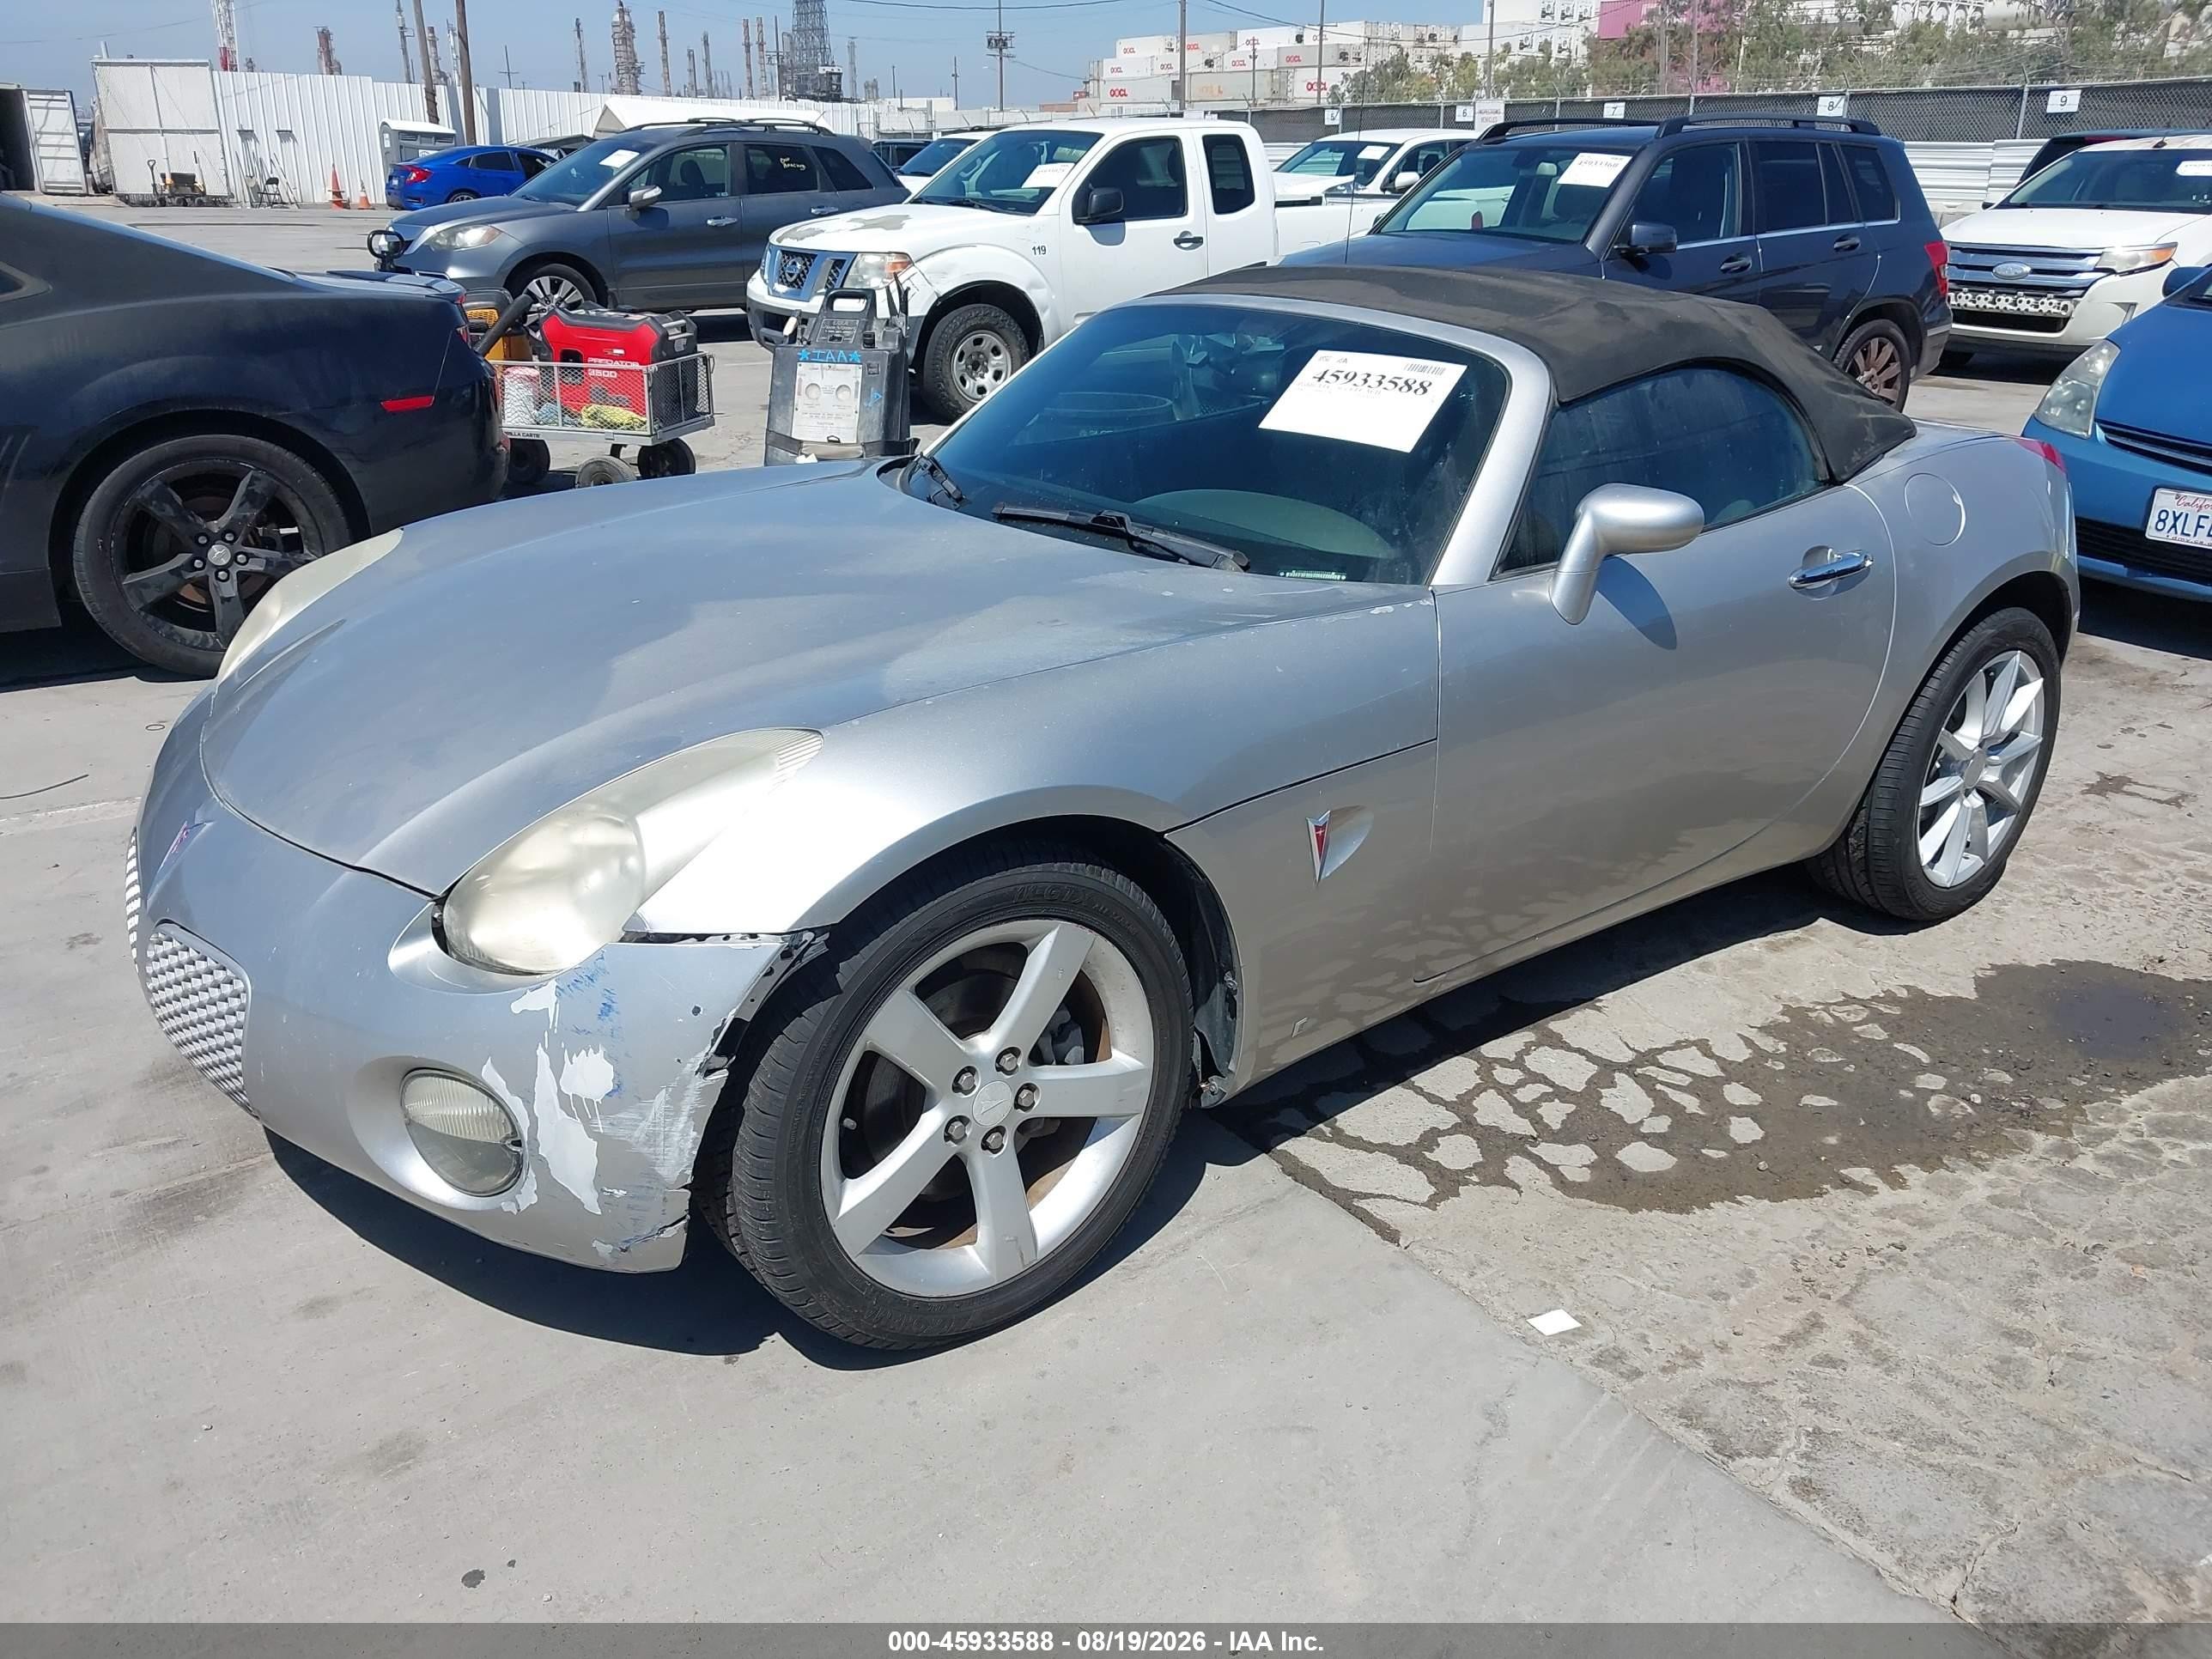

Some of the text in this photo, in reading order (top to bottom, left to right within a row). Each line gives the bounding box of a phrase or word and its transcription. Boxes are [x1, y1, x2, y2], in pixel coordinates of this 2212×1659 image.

[1109, 88, 1128, 97] OOCL
[1827, 100, 1835, 112] 8
[2060, 95, 2068, 107] 9
[1462, 108, 1468, 118] 6
[1612, 106, 1618, 116] 7
[1031, 245, 1047, 256] 119
[810, 349, 848, 362] IAA
[587, 357, 640, 368] PREDATOR
[587, 368, 617, 379] 3500
[1312, 368, 1433, 396] 45933588
